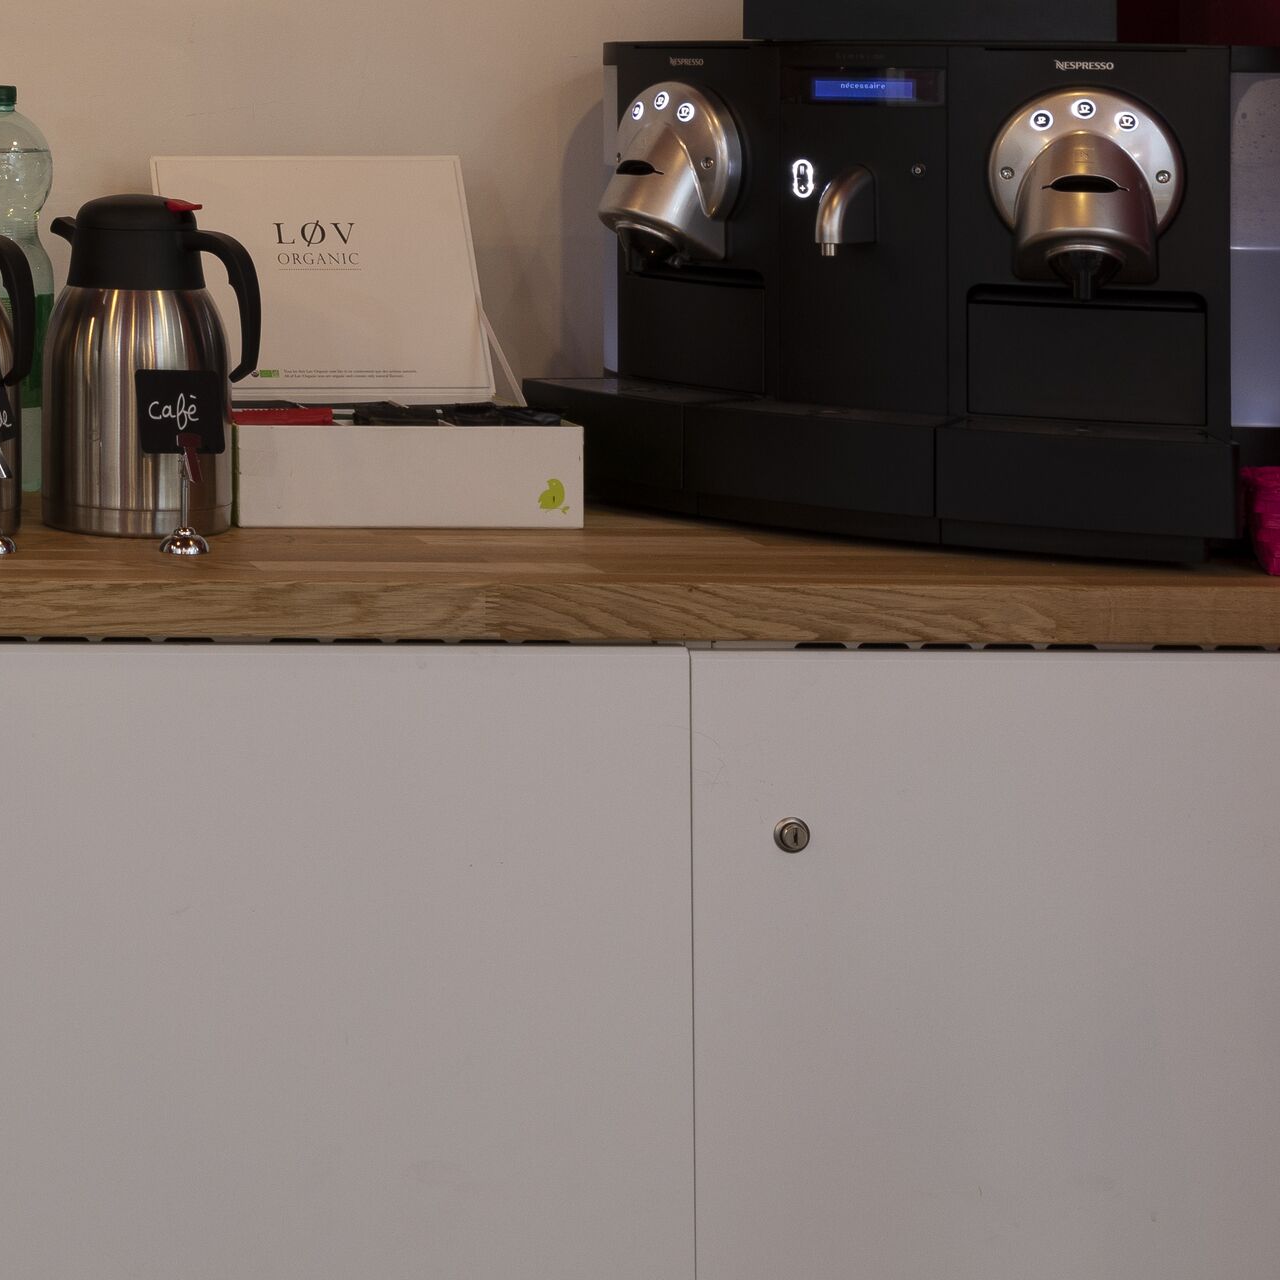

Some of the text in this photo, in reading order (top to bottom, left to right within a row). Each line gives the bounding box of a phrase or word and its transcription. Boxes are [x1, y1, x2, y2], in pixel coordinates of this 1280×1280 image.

[669, 56, 704, 67] NESPRESSO
[1053, 59, 1114, 71] NESPRESSO
[840, 82, 886, 90] nécessaire
[272, 220, 355, 247] LØV
[277, 252, 360, 265] ORGANIC
